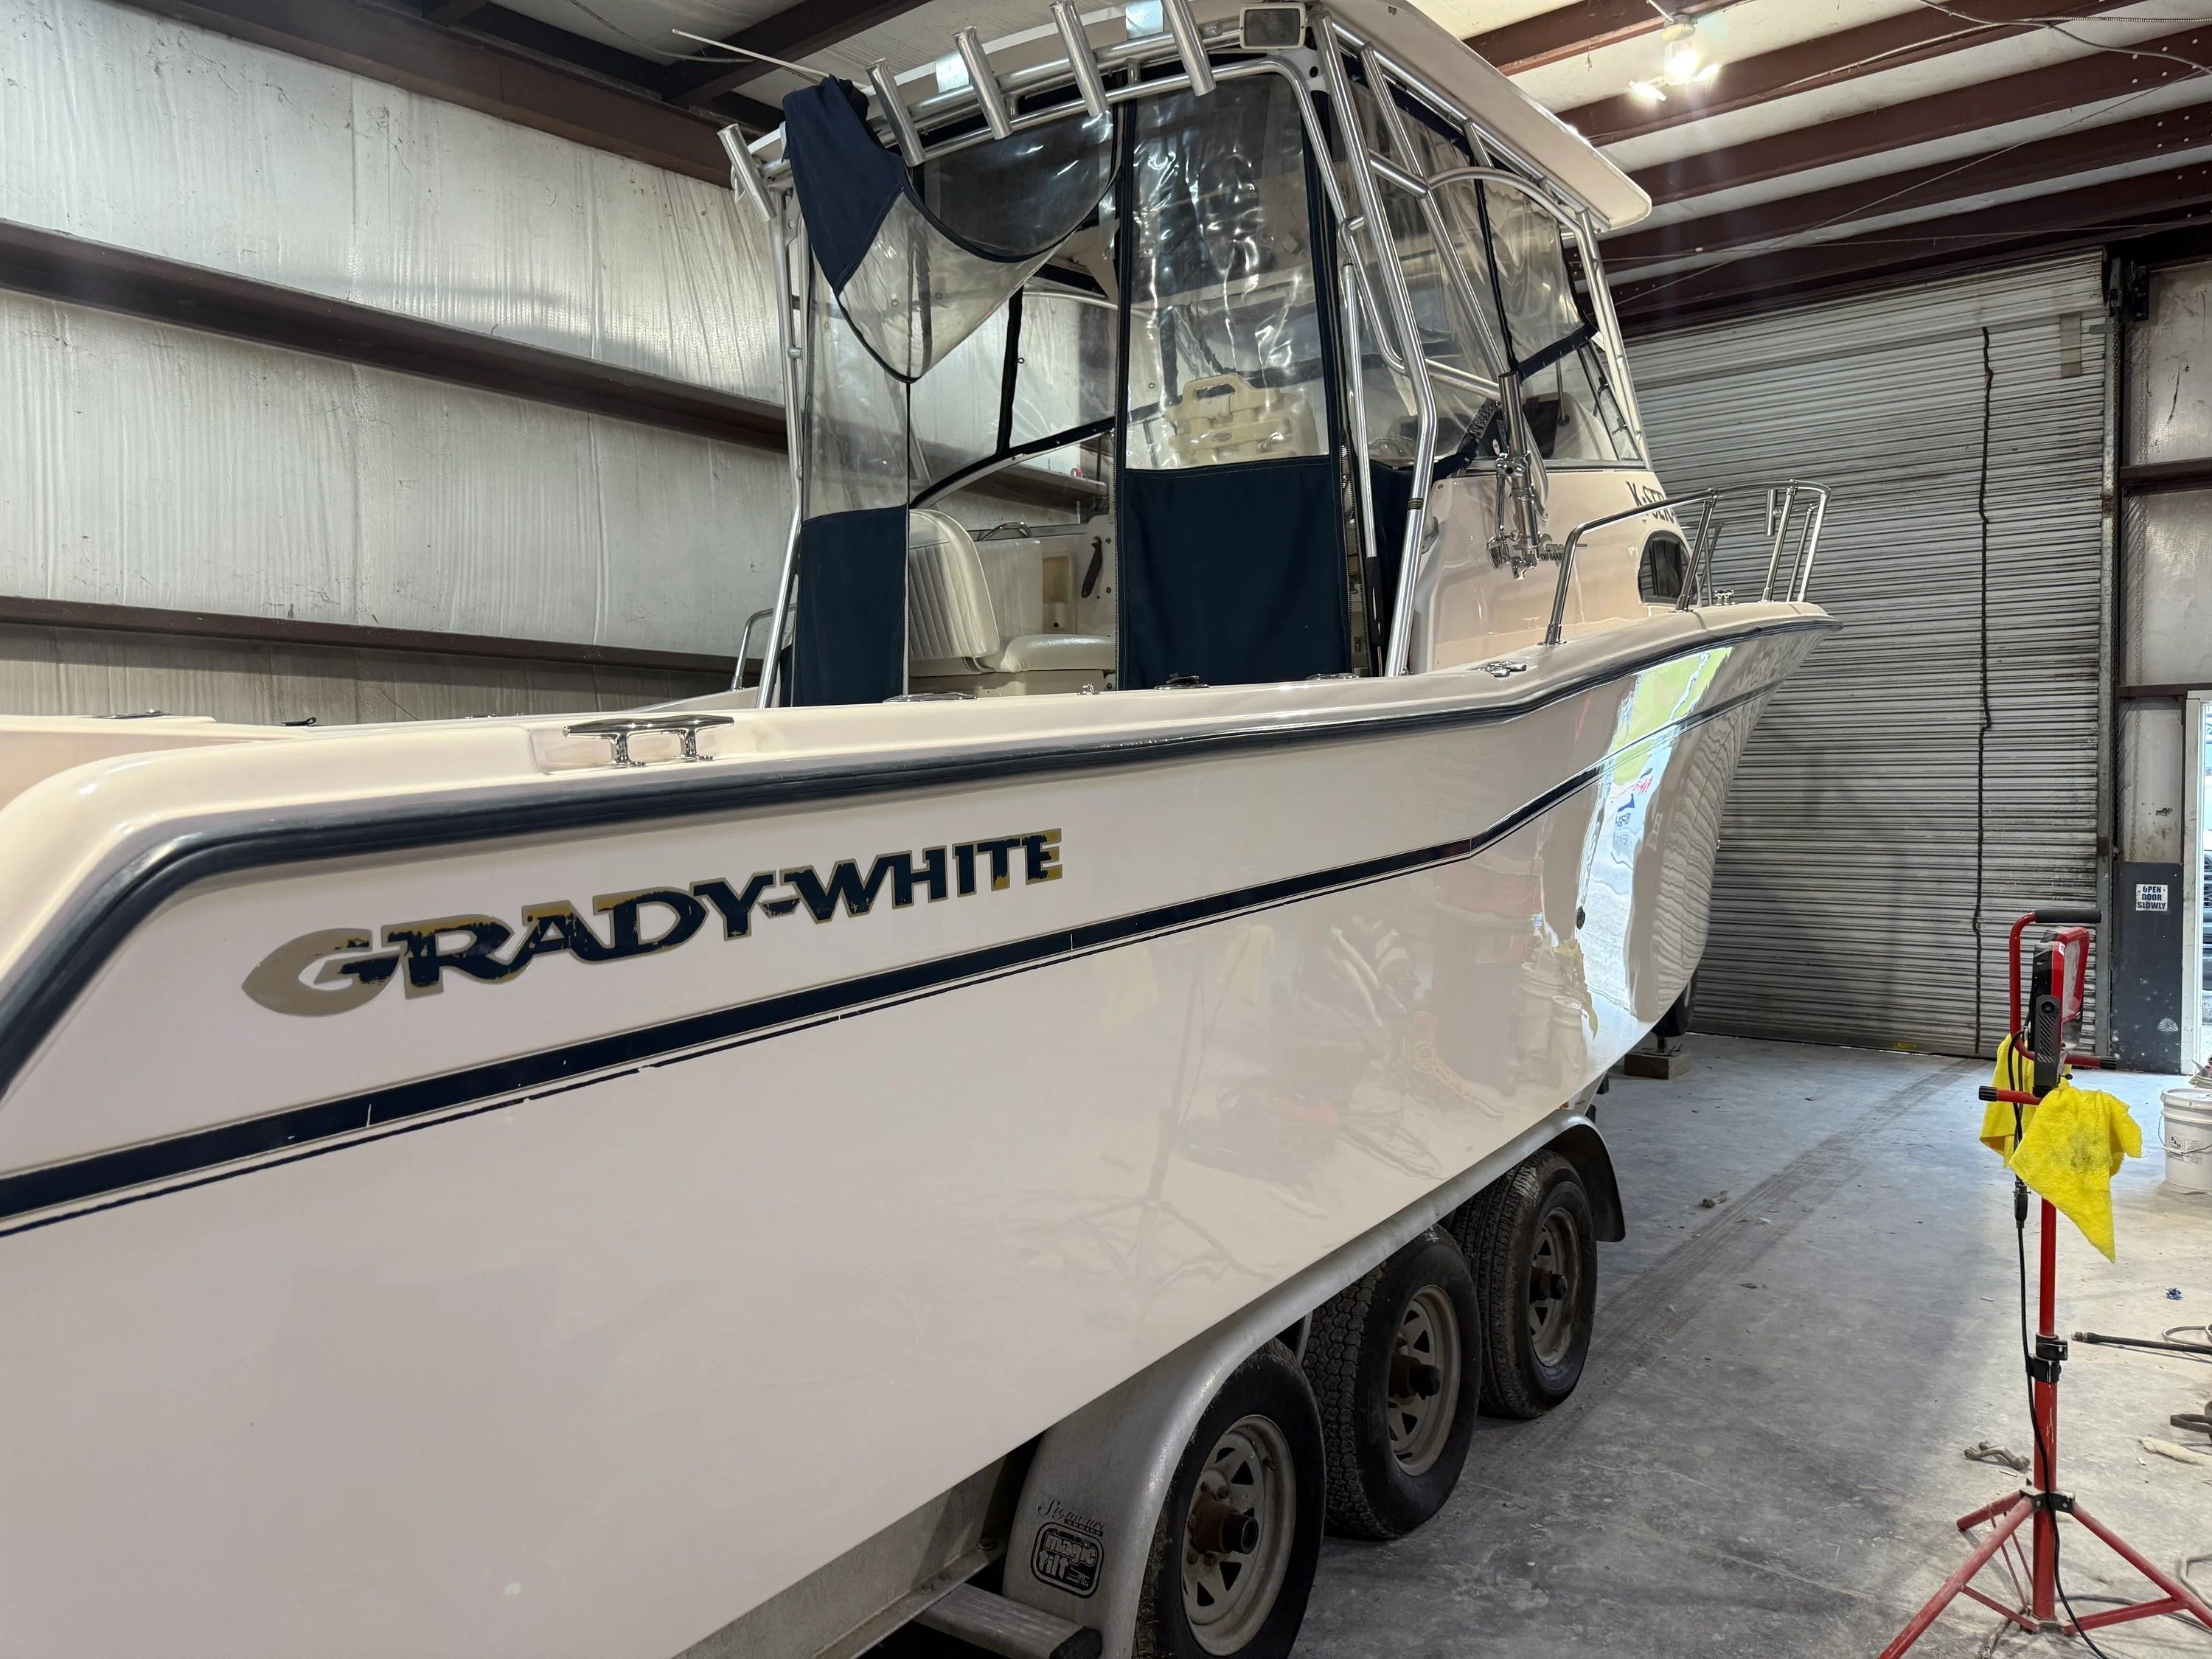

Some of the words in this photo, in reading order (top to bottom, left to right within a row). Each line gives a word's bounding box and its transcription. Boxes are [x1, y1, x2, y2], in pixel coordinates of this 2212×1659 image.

[242, 827, 1062, 1017] GRADY-WHITE
[1039, 1550, 1069, 1579] tilt
[1045, 1534, 1097, 1565] magic
